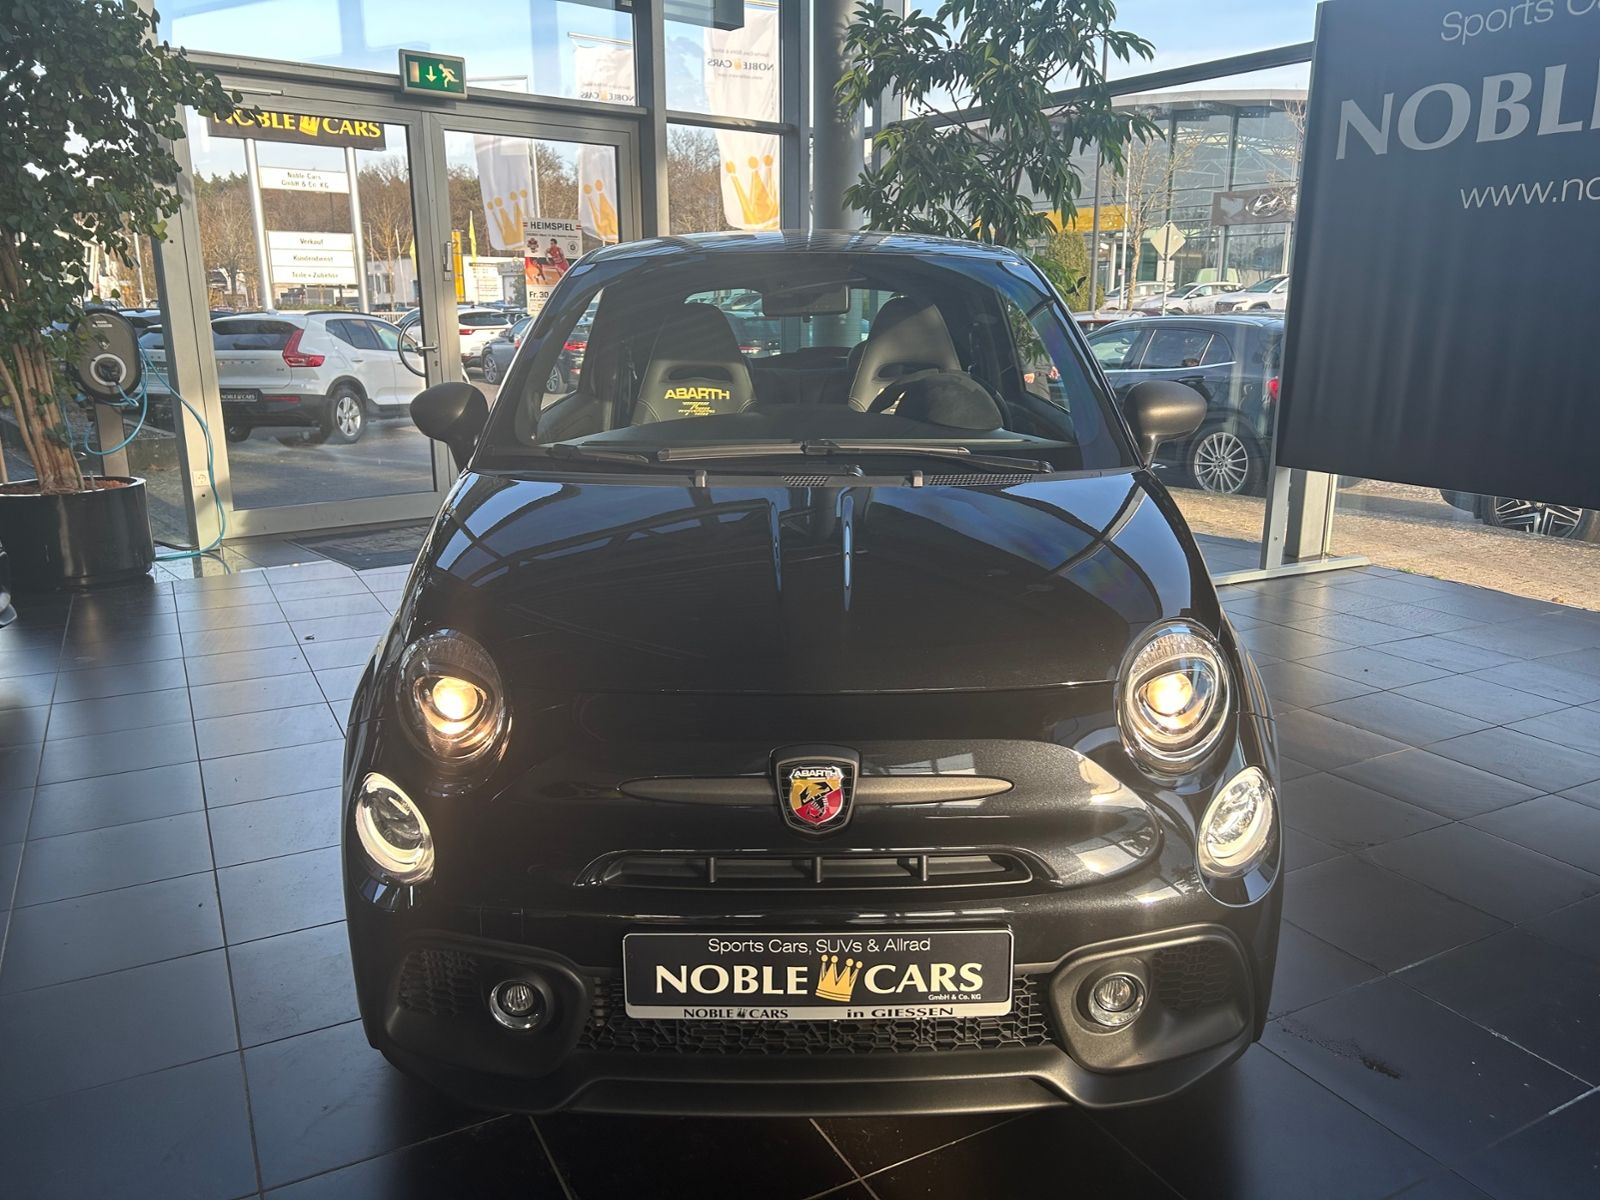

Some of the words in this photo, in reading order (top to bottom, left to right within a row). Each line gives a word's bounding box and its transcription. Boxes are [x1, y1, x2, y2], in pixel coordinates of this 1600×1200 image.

[1440, 0, 1554, 45] Sports
[1335, 57, 1600, 160] NOBL
[322, 118, 381, 138] CARS
[530, 221, 575, 231] HEIMSPIEL
[664, 387, 730, 400] ABARTH
[794, 769, 837, 777] ABARTH
[708, 938, 764, 955] Sports
[768, 939, 812, 956] Cars,
[815, 939, 862, 953] SUVs
[868, 938, 880, 952] &
[884, 938, 931, 952] Allrad
[655, 964, 809, 994] NOBLE
[864, 962, 984, 994] CARS
[971, 993, 982, 1001] KG
[683, 1008, 734, 1018] NOBLE
[749, 1008, 788, 1018] CARS
[847, 1009, 864, 1018] in
[871, 1008, 954, 1018] GIESSEN
